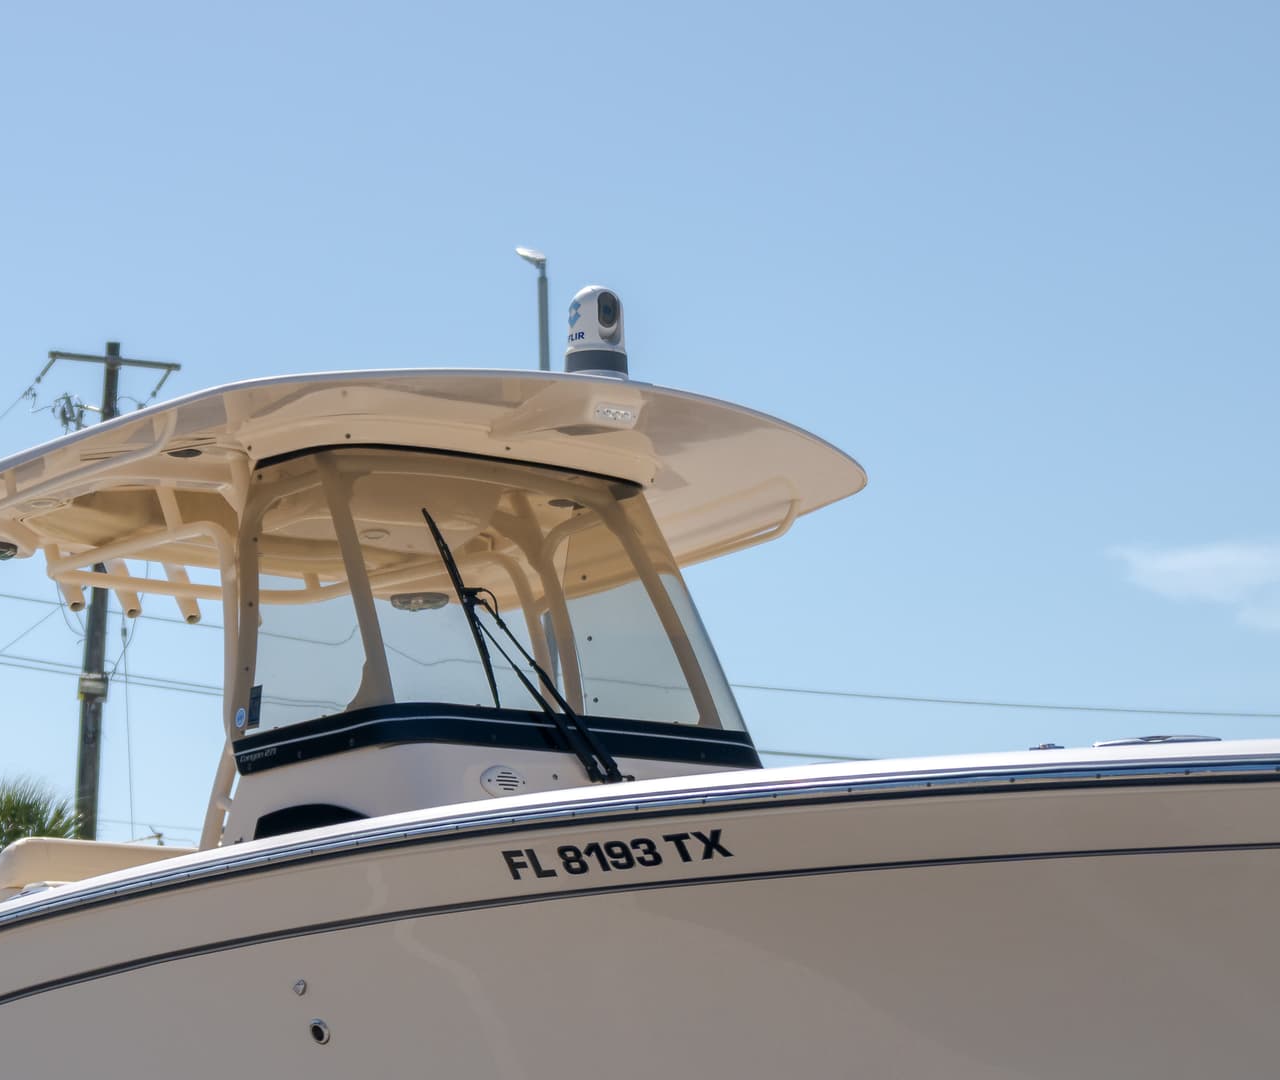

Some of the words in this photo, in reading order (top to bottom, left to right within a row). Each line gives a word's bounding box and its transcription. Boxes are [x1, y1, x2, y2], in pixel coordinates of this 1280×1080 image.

[501, 848, 558, 880] FL
[556, 837, 663, 875] 8193
[662, 828, 734, 863] TX
